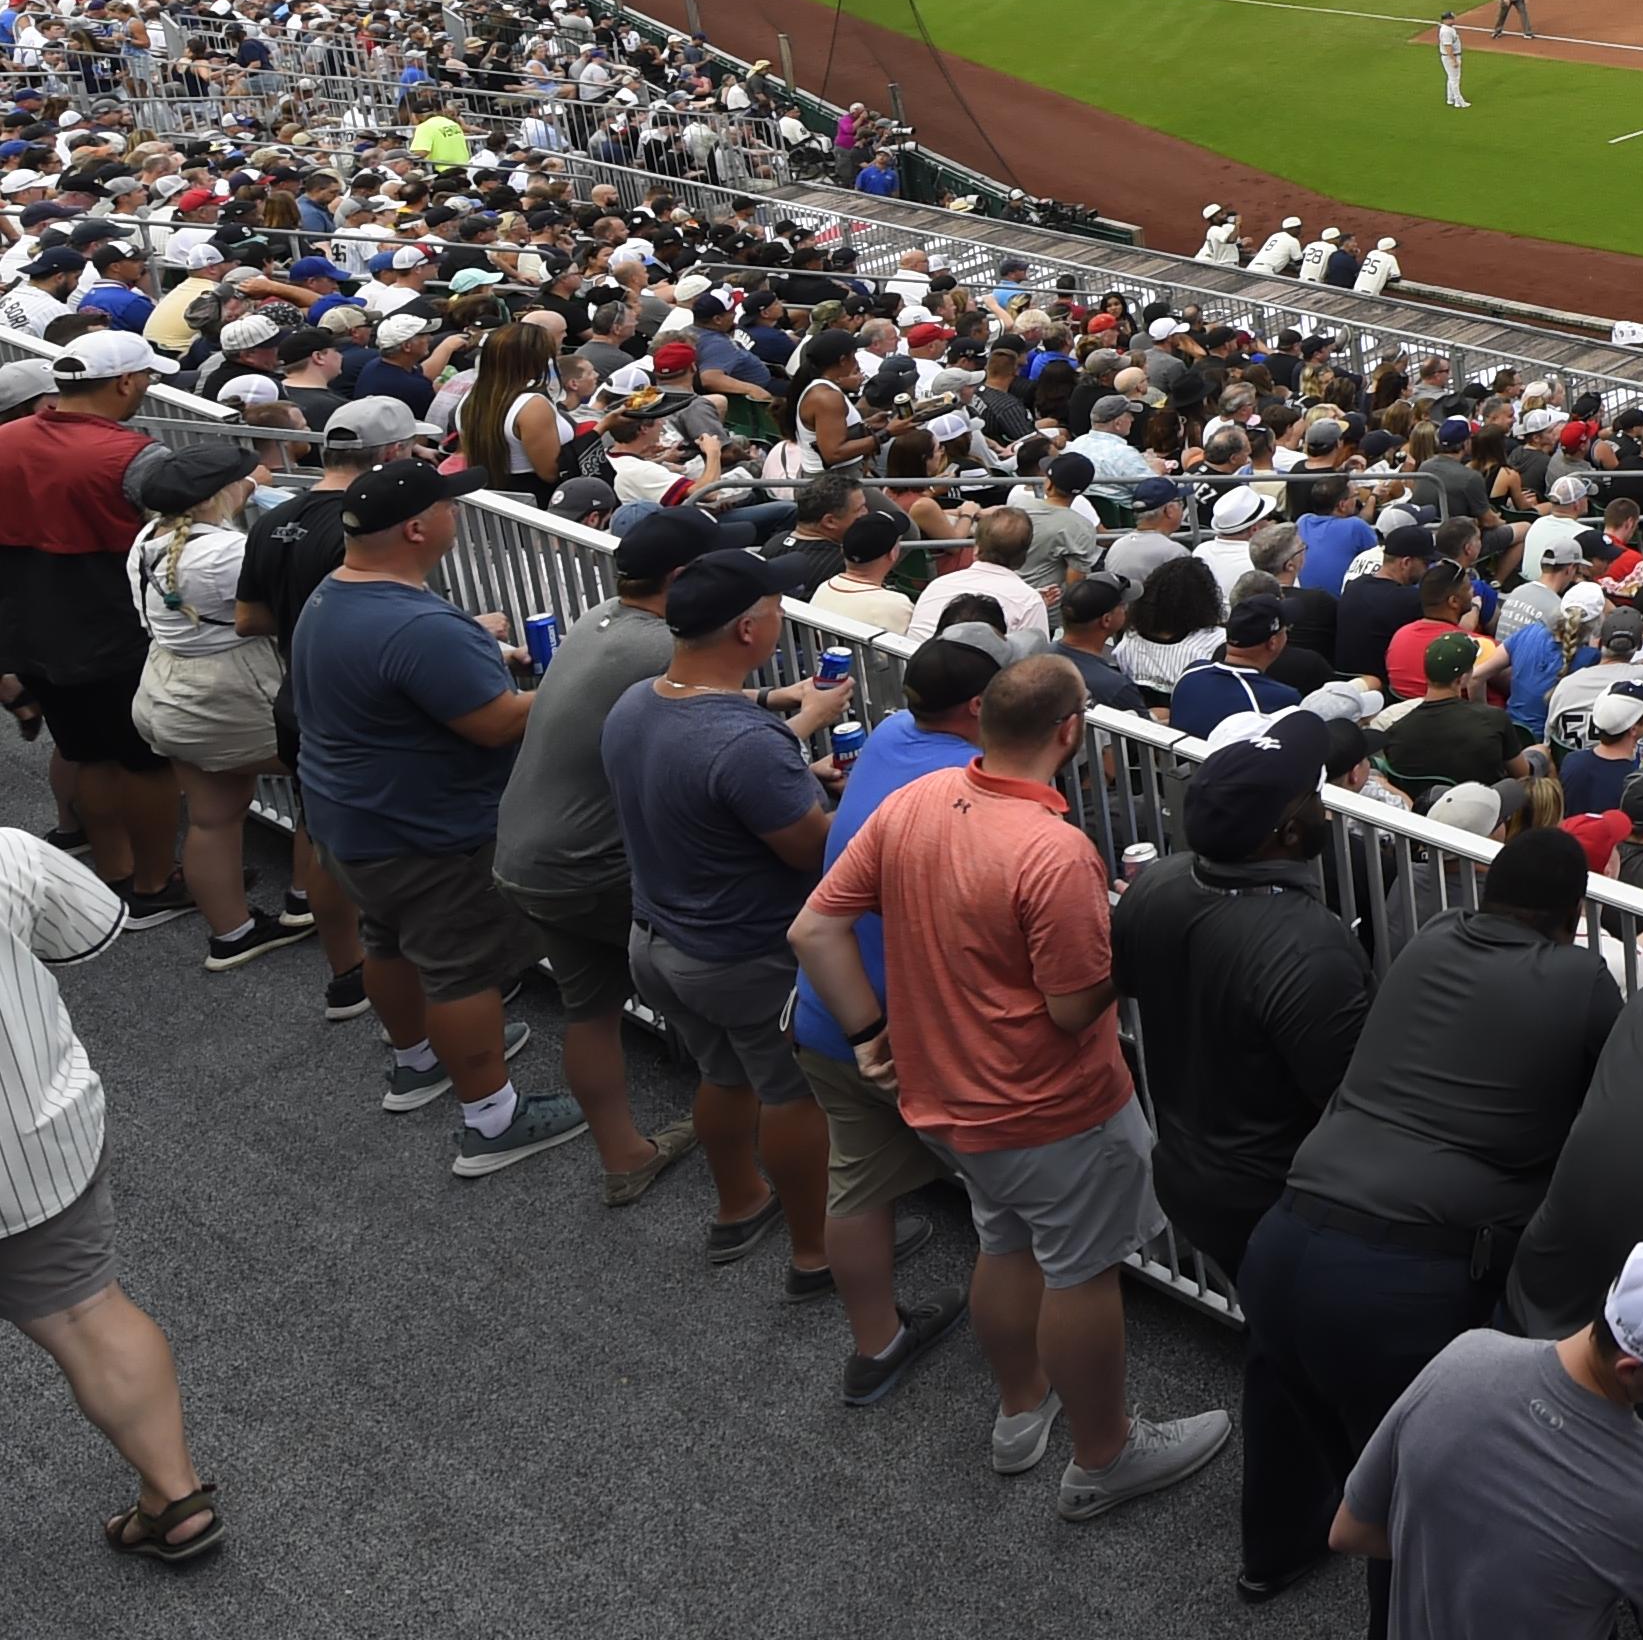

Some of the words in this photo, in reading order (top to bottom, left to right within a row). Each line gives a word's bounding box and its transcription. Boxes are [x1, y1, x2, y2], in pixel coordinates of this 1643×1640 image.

[1264, 239, 1278, 251] 8
[1305, 247, 1324, 264] 28
[1361, 257, 1381, 275] 25
